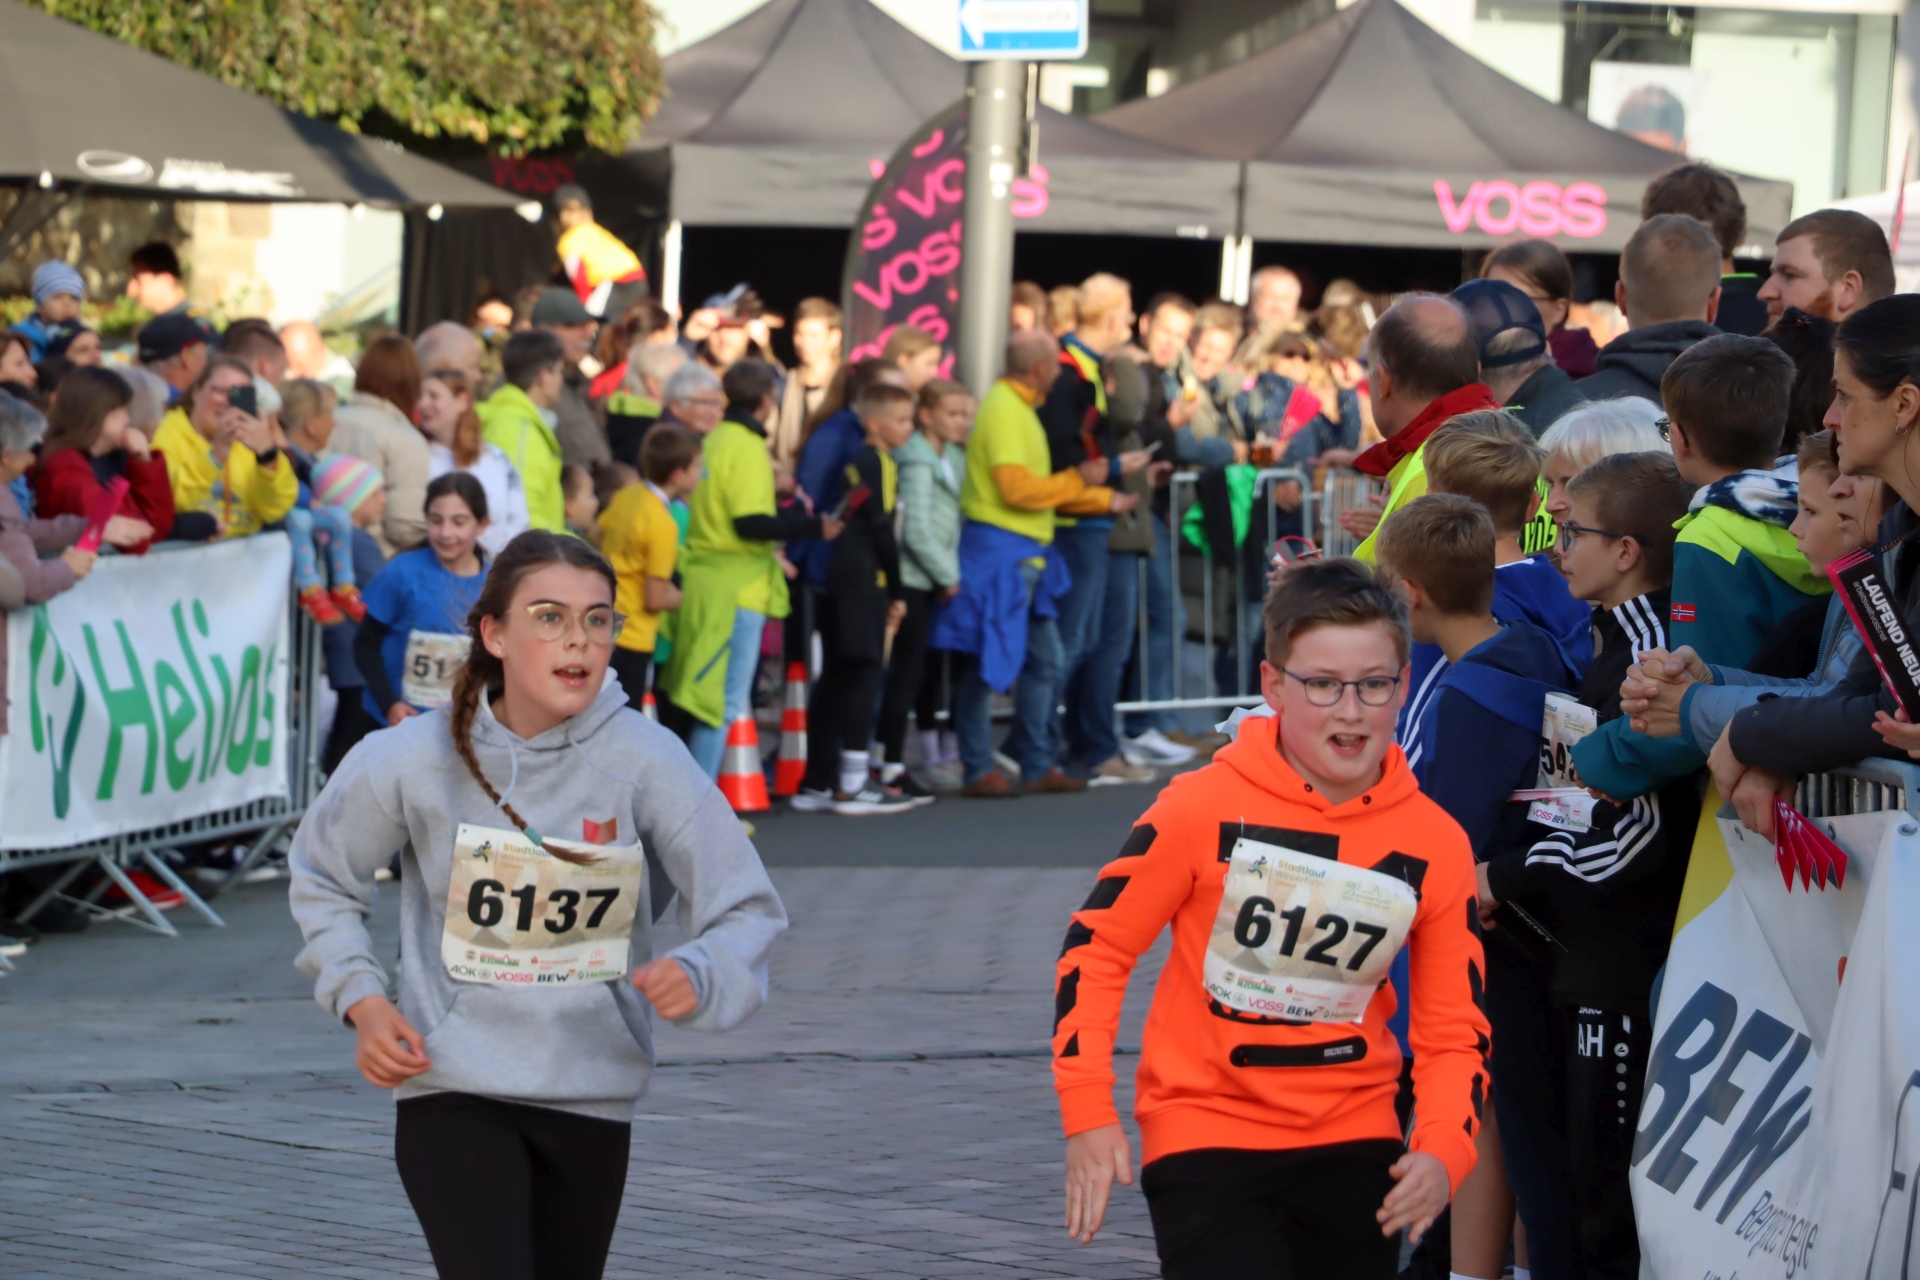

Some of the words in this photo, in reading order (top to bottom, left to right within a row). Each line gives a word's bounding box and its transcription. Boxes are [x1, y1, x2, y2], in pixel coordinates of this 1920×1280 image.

[1433, 179, 1608, 239] VOSS
[1861, 573, 1905, 645] LAUFEND
[1896, 642, 1920, 697] NEUE
[413, 653, 448, 681] 51
[81, 597, 277, 801] Helios
[1532, 808, 1553, 821] VOSS
[503, 842, 553, 858] Stadtlau
[1277, 859, 1327, 879] Stadtlauf
[467, 878, 620, 934] 6137
[1233, 895, 1388, 971] 6127
[450, 964, 477, 977] AOK
[493, 971, 534, 983] VOSS
[537, 971, 570, 983] BEW
[584, 969, 617, 979] Helios
[1209, 983, 1232, 1001] AOK
[1248, 997, 1285, 1014] VOSS
[1286, 1005, 1318, 1018] BEW
[1577, 1022, 1605, 1058] AH
[1630, 980, 1813, 1225] BEW
